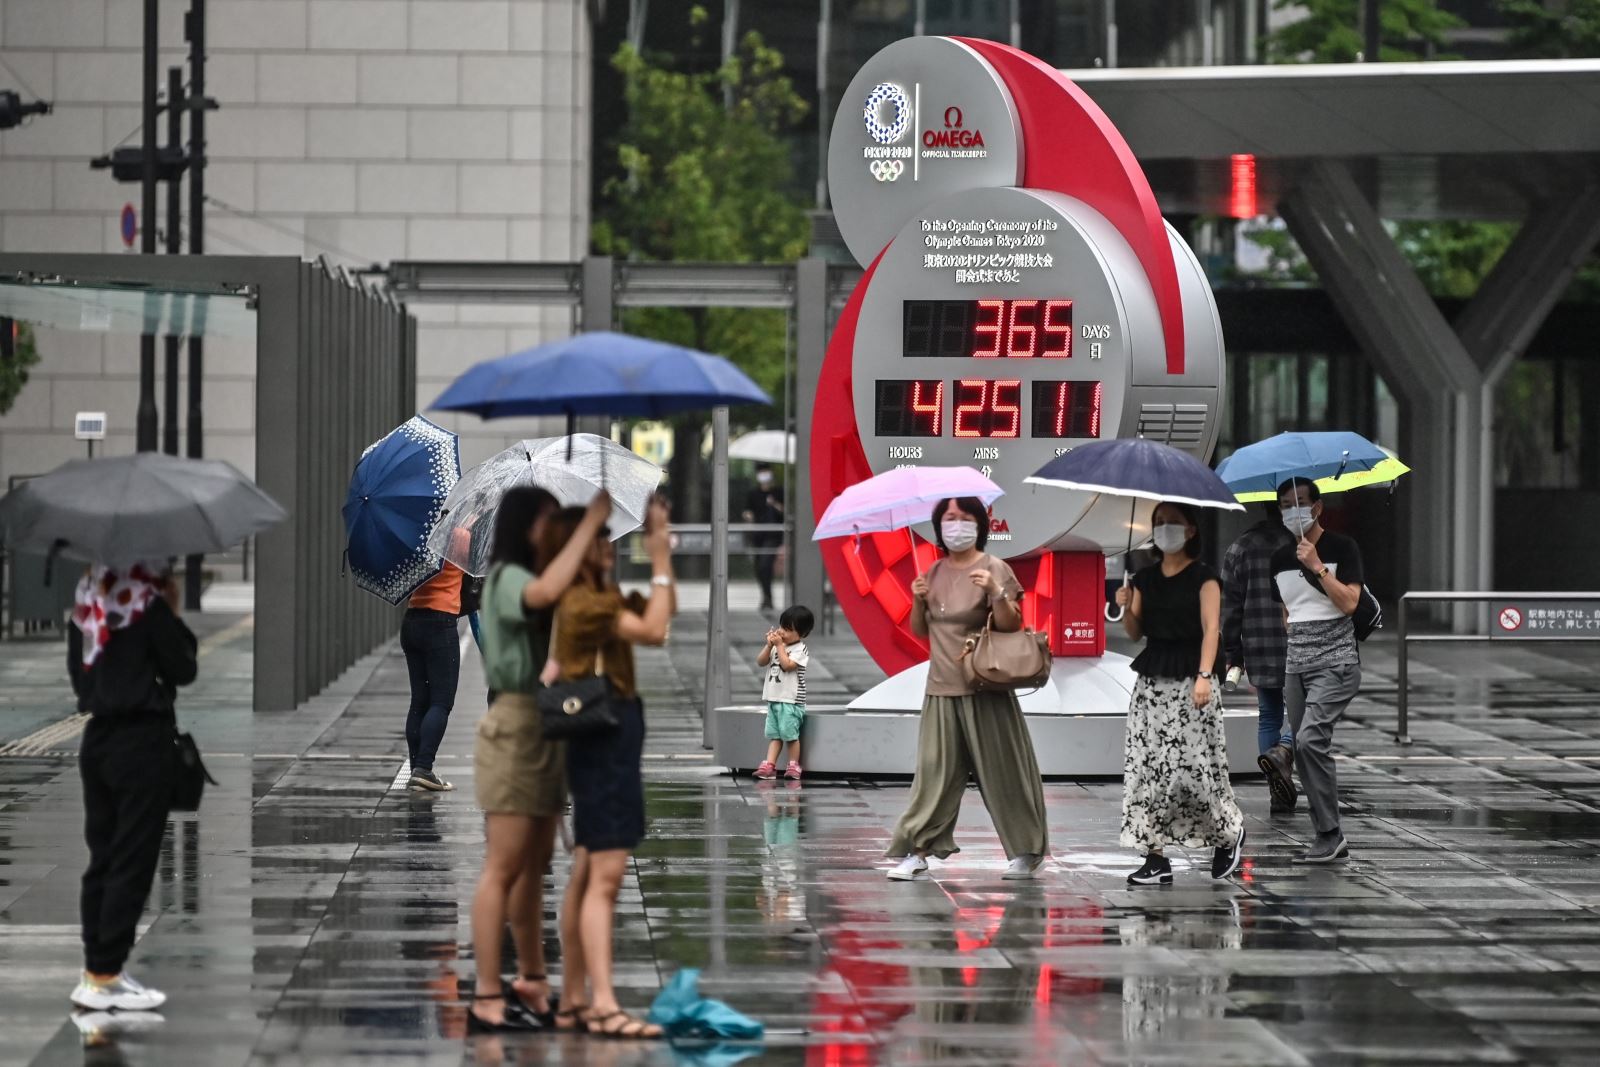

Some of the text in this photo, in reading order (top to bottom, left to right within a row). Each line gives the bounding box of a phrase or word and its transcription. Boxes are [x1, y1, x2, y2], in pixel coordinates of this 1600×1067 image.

[922, 130, 985, 149] OMEGA
[864, 147, 912, 158] TOKYO 2020
[921, 150, 987, 159] OFFICIAL TIMEKEEPER
[920, 219, 1058, 234] To the Opening Ceremony of the
[924, 234, 1045, 249] Olympic Games Tokyo 2020
[923, 253, 1053, 268] 東京2020オリンピック競技大会
[973, 300, 1072, 357] 365
[1081, 324, 1110, 339] DAYS
[1090, 342, 1102, 359] 日
[913, 380, 1101, 437] 4 25 11
[888, 446, 922, 459] HOURS
[973, 447, 999, 460] MINS
